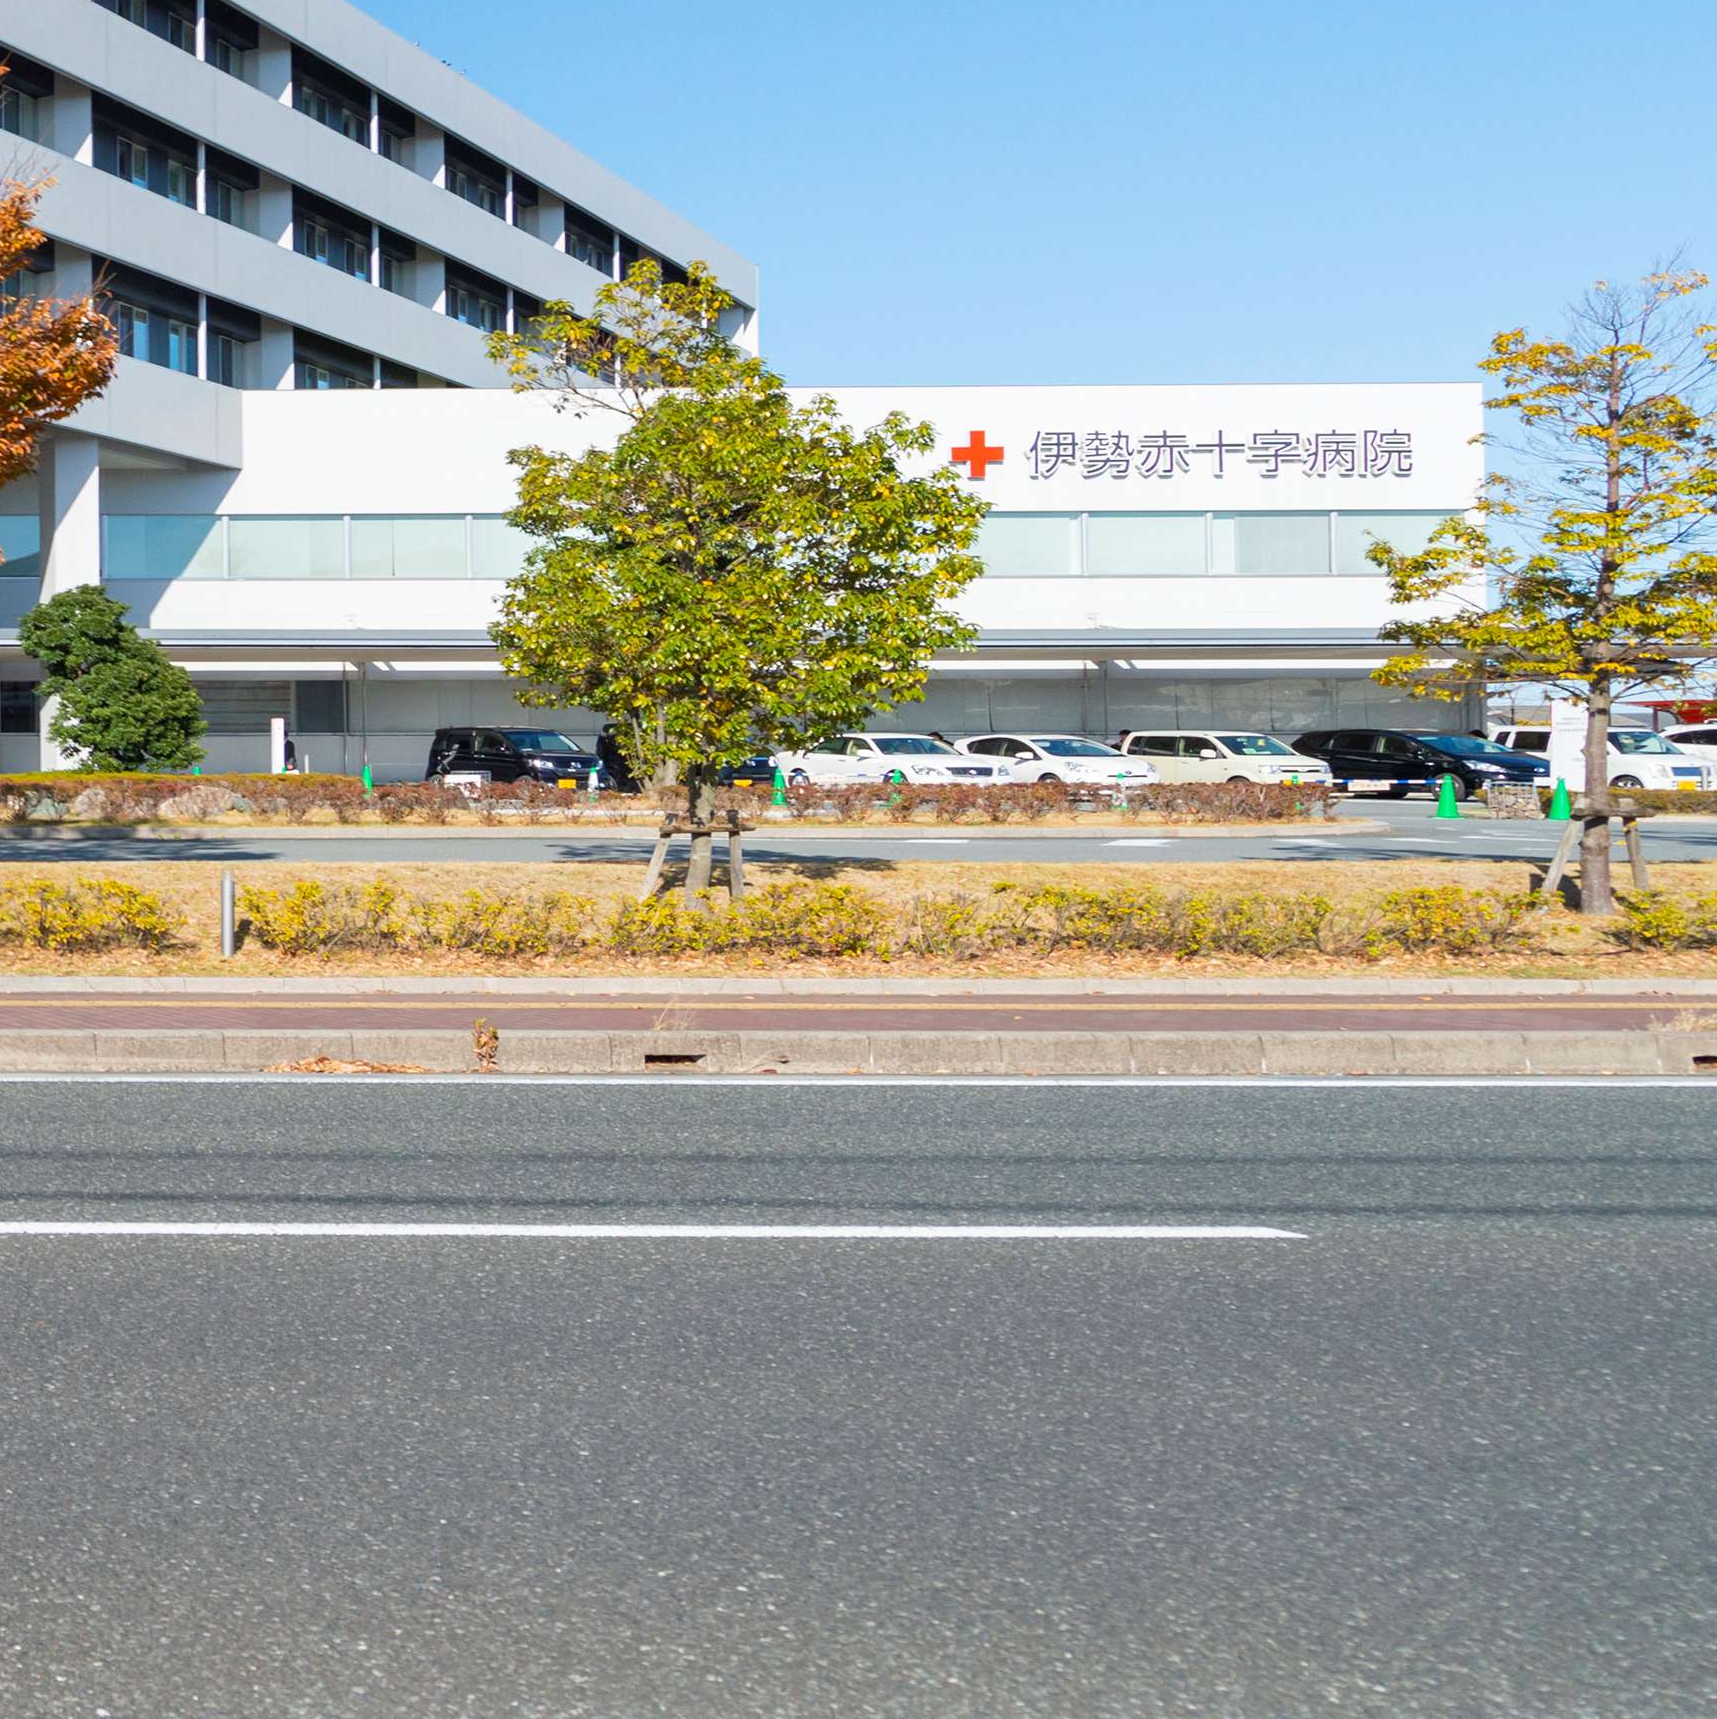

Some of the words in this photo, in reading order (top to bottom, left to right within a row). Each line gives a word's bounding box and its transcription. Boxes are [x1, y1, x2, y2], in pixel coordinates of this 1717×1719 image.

[1029, 429, 1414, 477] 伊勢赤十字病院
